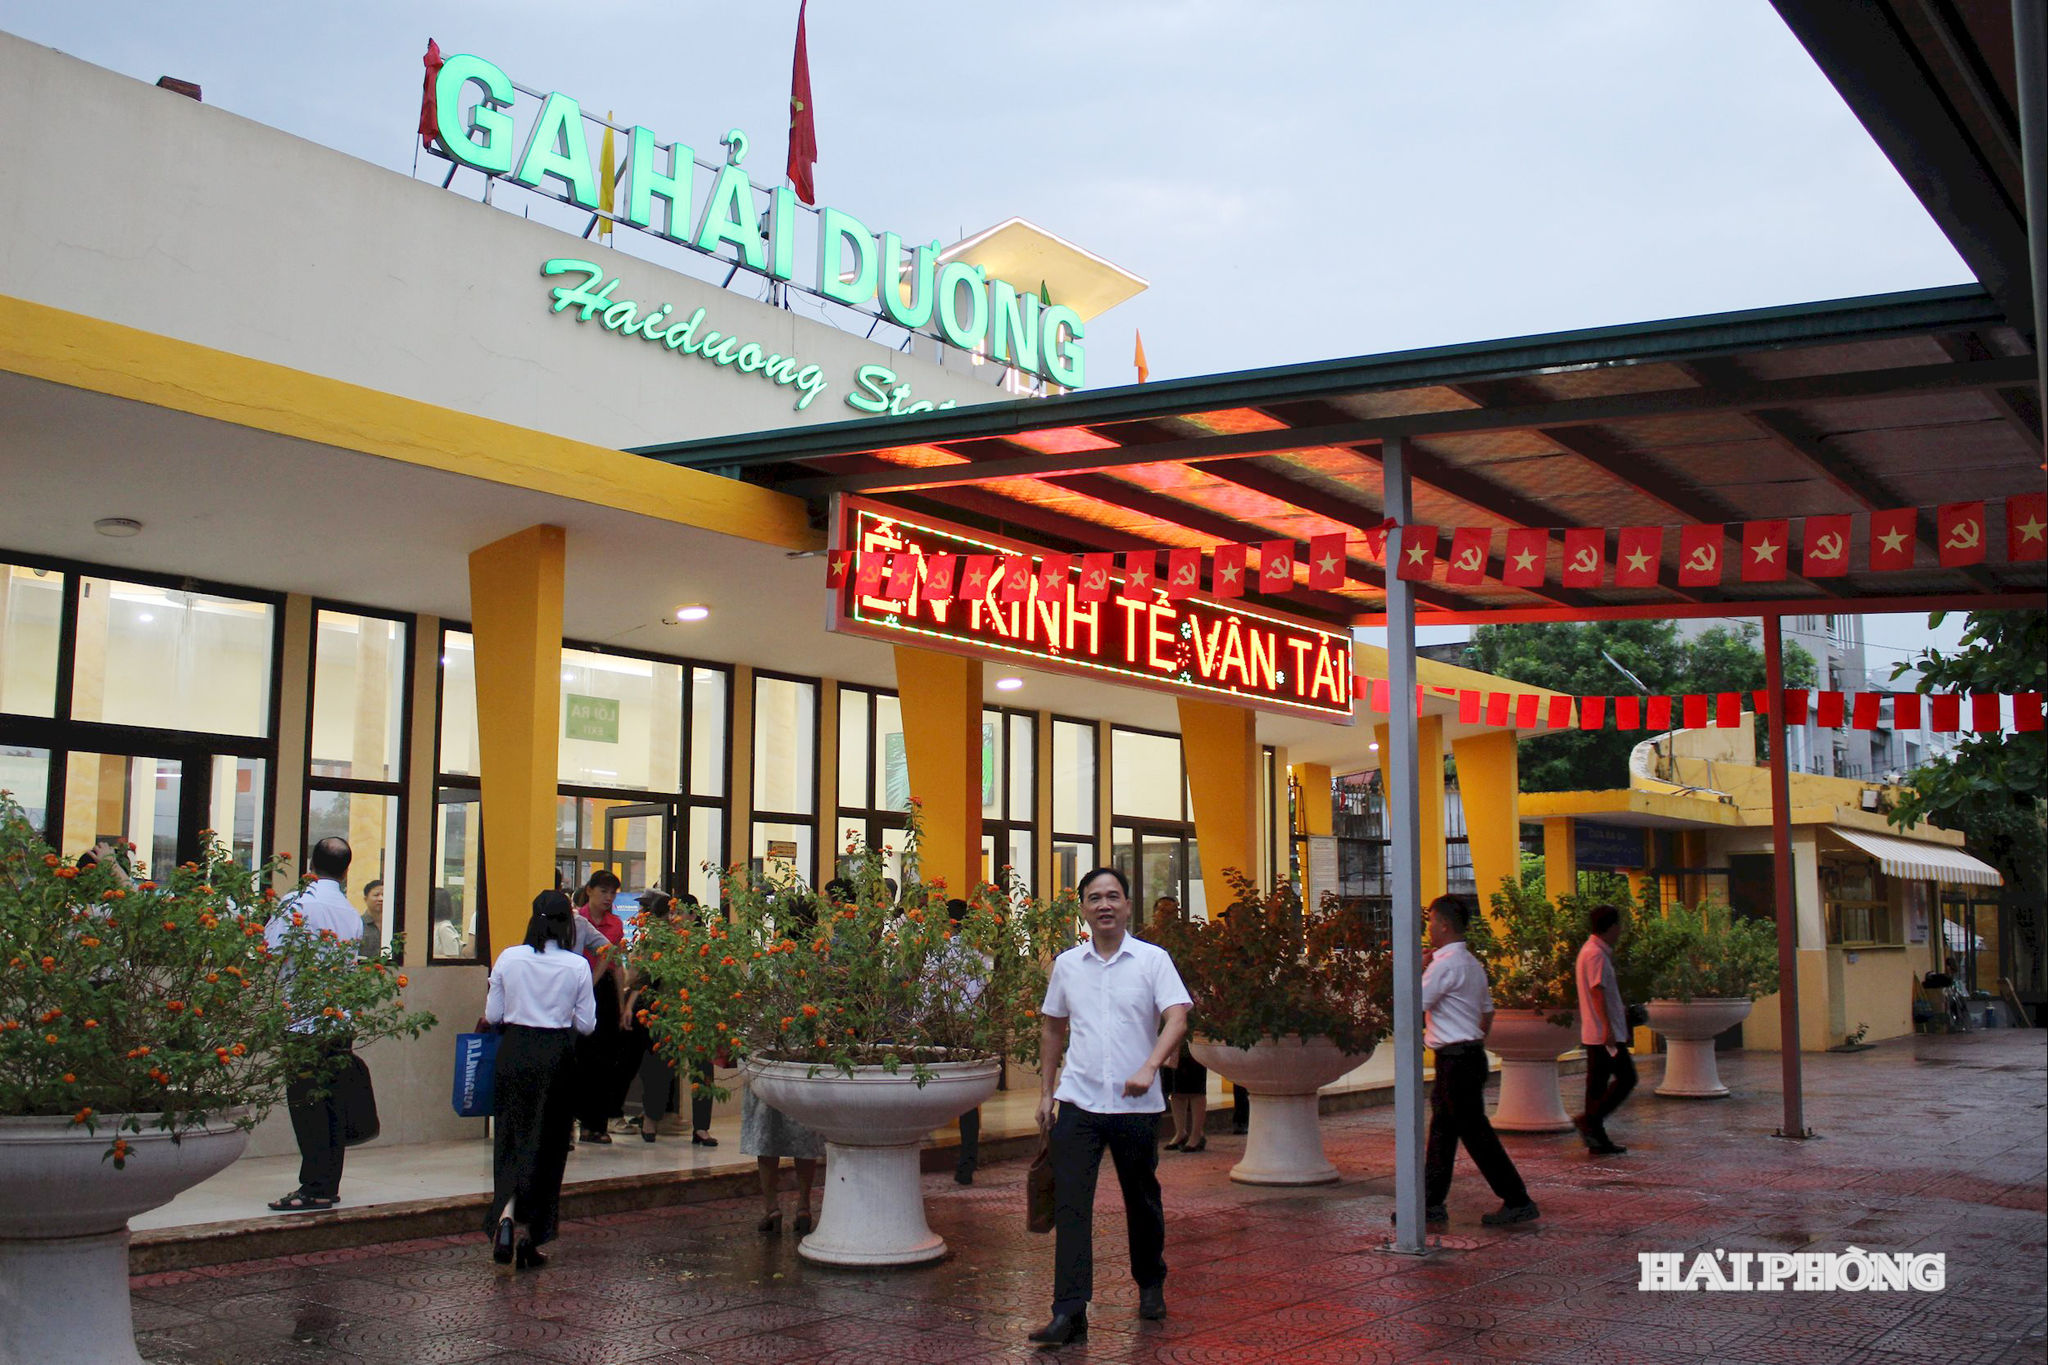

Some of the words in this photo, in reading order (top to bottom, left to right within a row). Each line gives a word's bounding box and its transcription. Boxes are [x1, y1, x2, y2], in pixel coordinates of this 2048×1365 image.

[436, 53, 600, 210] GA
[624, 125, 796, 281] HẢI
[816, 206, 1085, 389] DƯƠNG
[542, 257, 828, 411] Haiduong
[1287, 632, 1346, 704] TẢI
